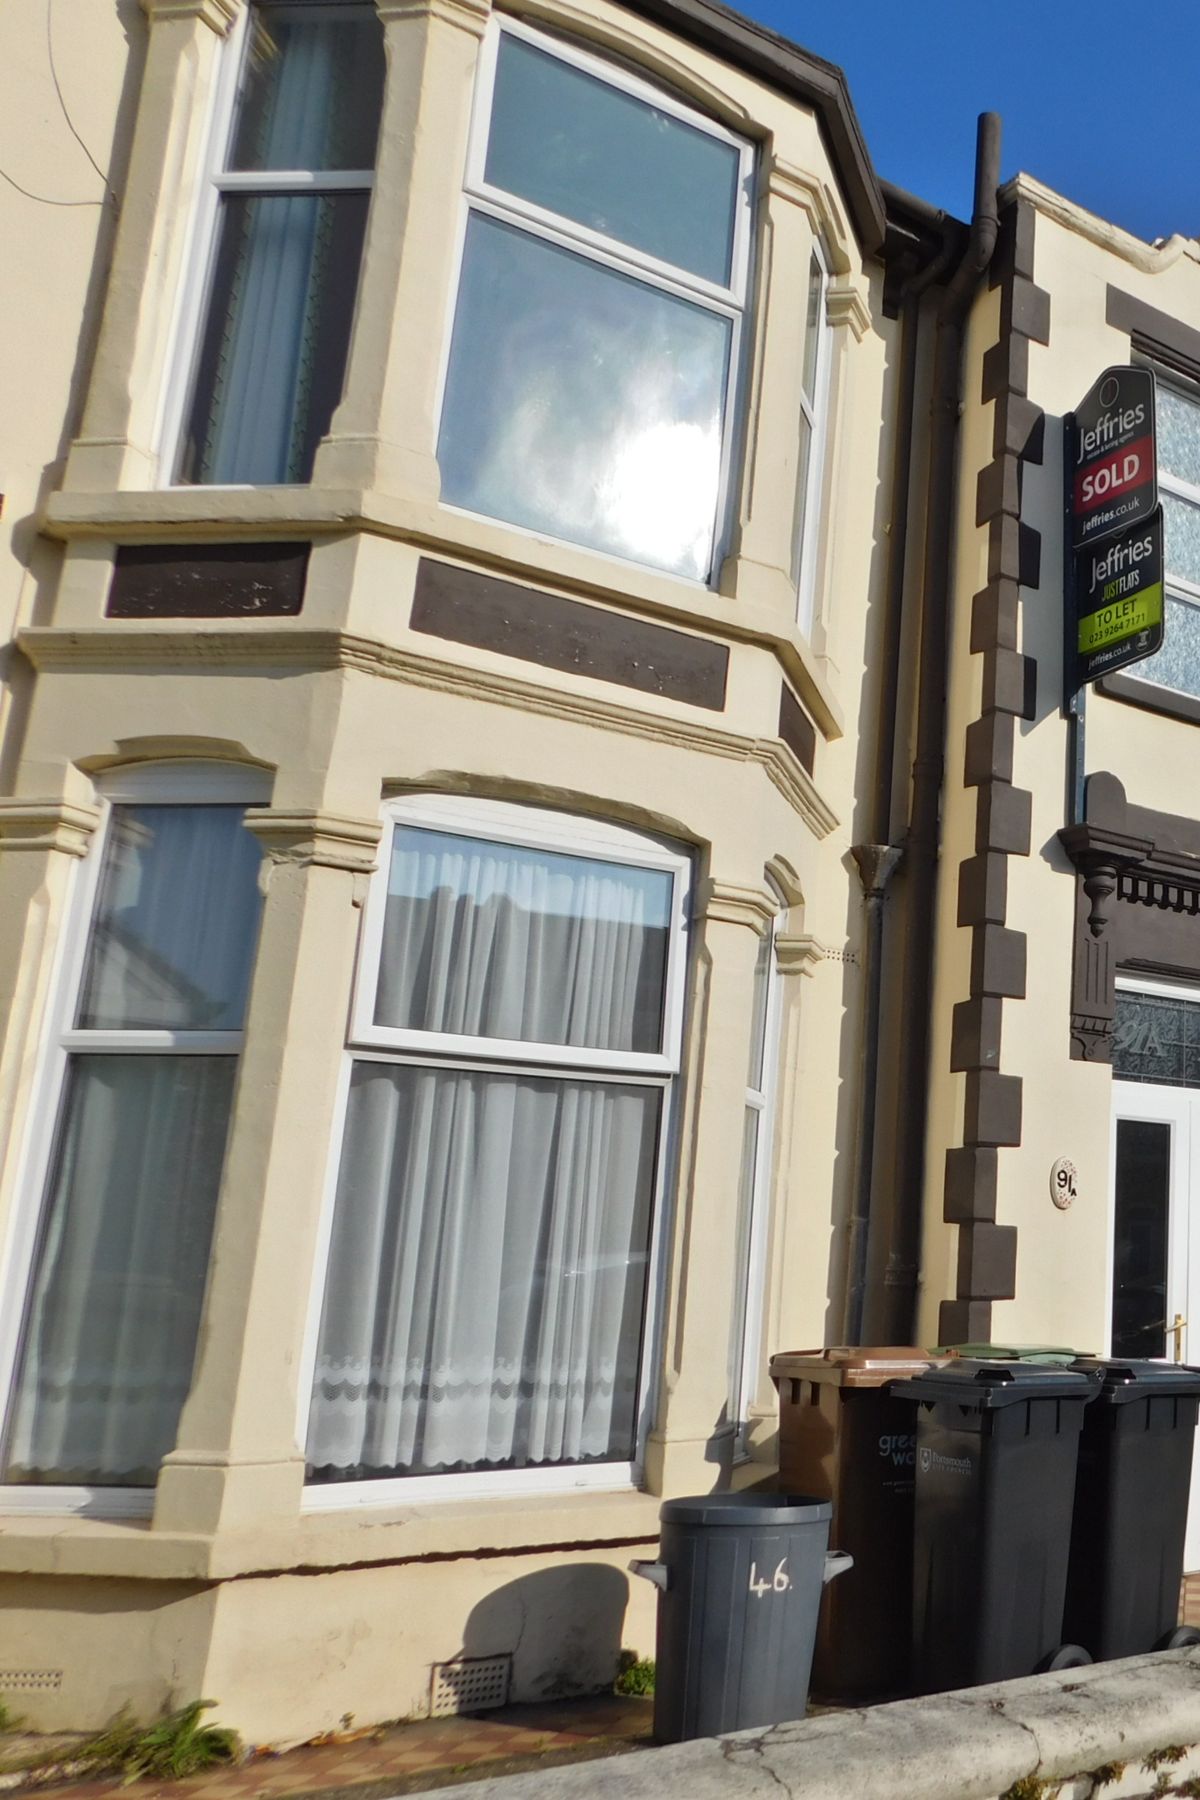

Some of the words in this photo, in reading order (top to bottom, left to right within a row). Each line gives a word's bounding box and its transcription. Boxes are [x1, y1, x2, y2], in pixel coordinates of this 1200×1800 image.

[1077, 404, 1145, 464] Jeffries
[1082, 454, 1140, 502] SOLD
[1082, 496, 1140, 536] jeffries.co.uk
[1089, 536, 1153, 594] Jeffries
[1097, 609, 1113, 627] TO
[1115, 598, 1137, 619] LET
[1089, 630, 1103, 644] 023
[1057, 1169, 1077, 1197] 91A
